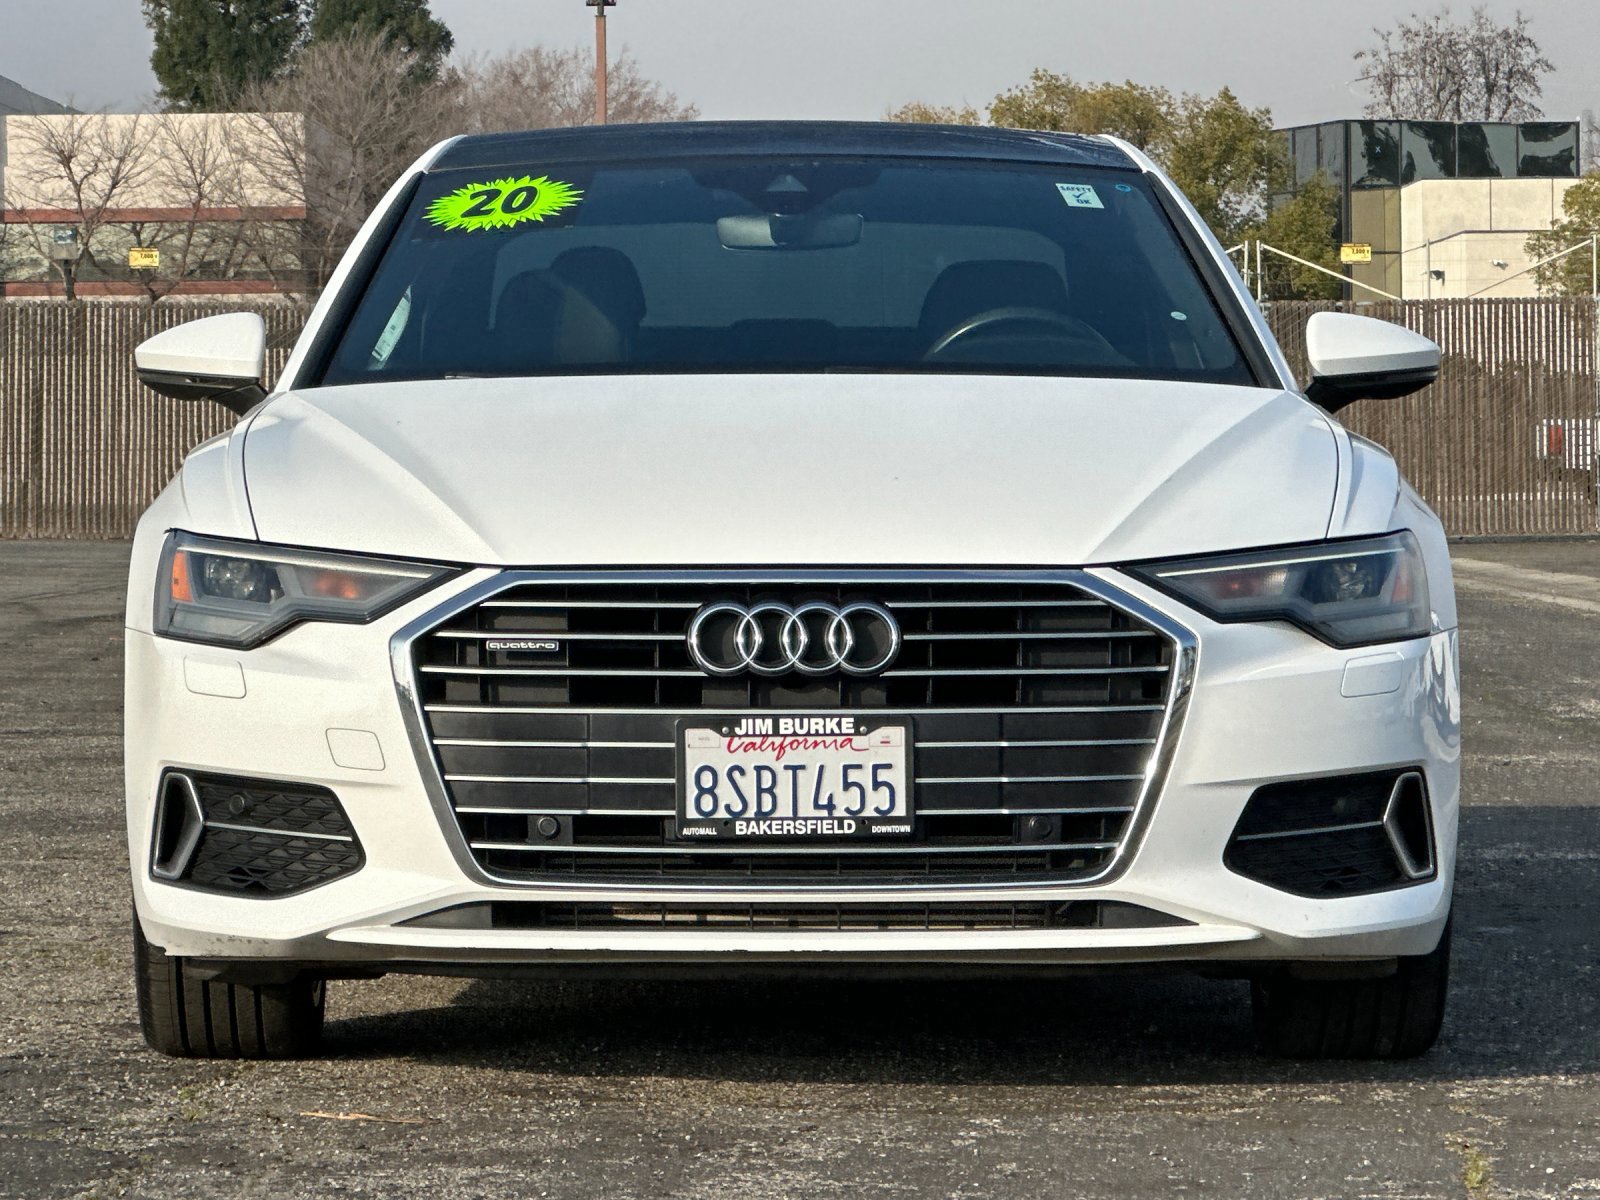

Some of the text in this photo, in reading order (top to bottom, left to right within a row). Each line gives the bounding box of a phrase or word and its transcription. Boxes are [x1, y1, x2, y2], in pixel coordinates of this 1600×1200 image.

[1060, 185, 1092, 193] SAFETY
[460, 185, 539, 219] 20
[489, 641, 556, 650] quattro
[734, 717, 855, 735] JIM BURKE
[726, 736, 870, 761] California
[694, 763, 896, 818] 8SBT455
[682, 827, 718, 836] AUTOMALL
[735, 819, 856, 835] BAKERSFIELD
[871, 825, 911, 834] DOWNTOWN
